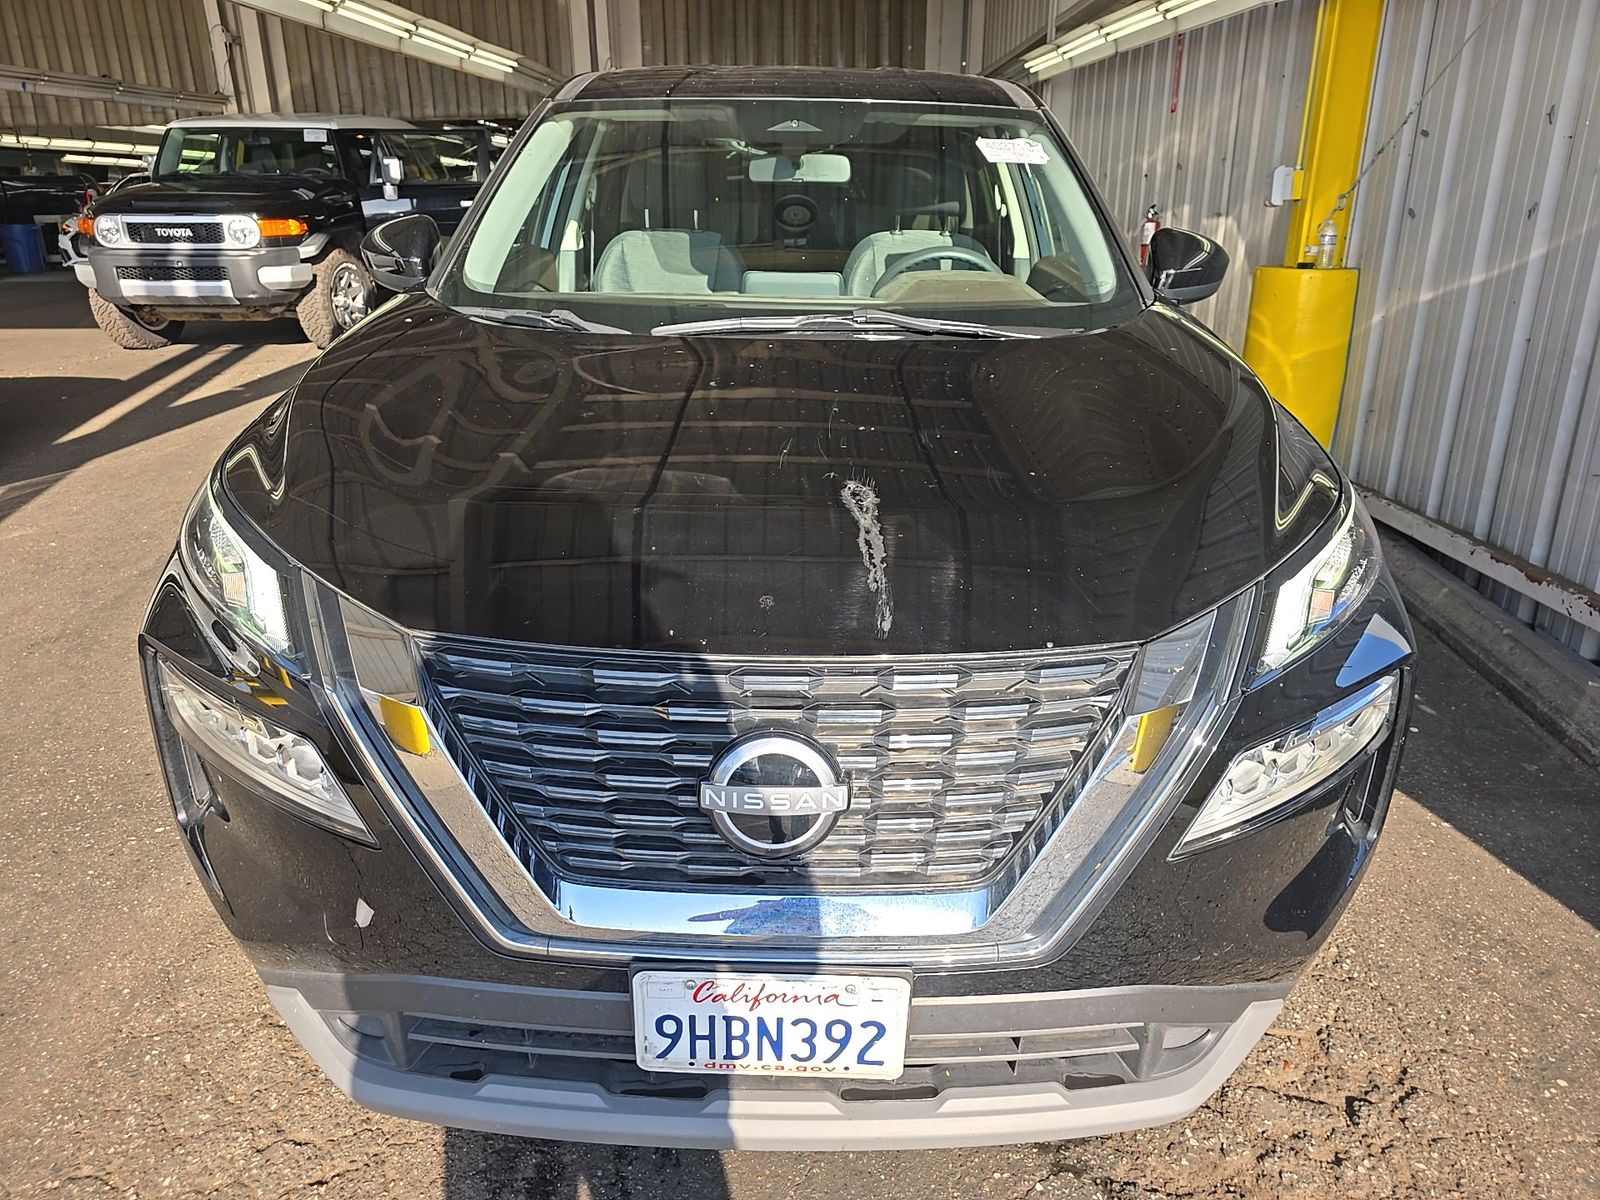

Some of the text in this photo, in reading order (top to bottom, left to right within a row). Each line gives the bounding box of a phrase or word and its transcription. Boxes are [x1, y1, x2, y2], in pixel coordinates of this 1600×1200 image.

[155, 227, 193, 238] TOYOTA
[705, 788, 843, 811] NISSAN
[692, 980, 858, 1012] California
[654, 1014, 887, 1066] 9HBN392
[703, 1061, 837, 1073] dmv.ca.gov
